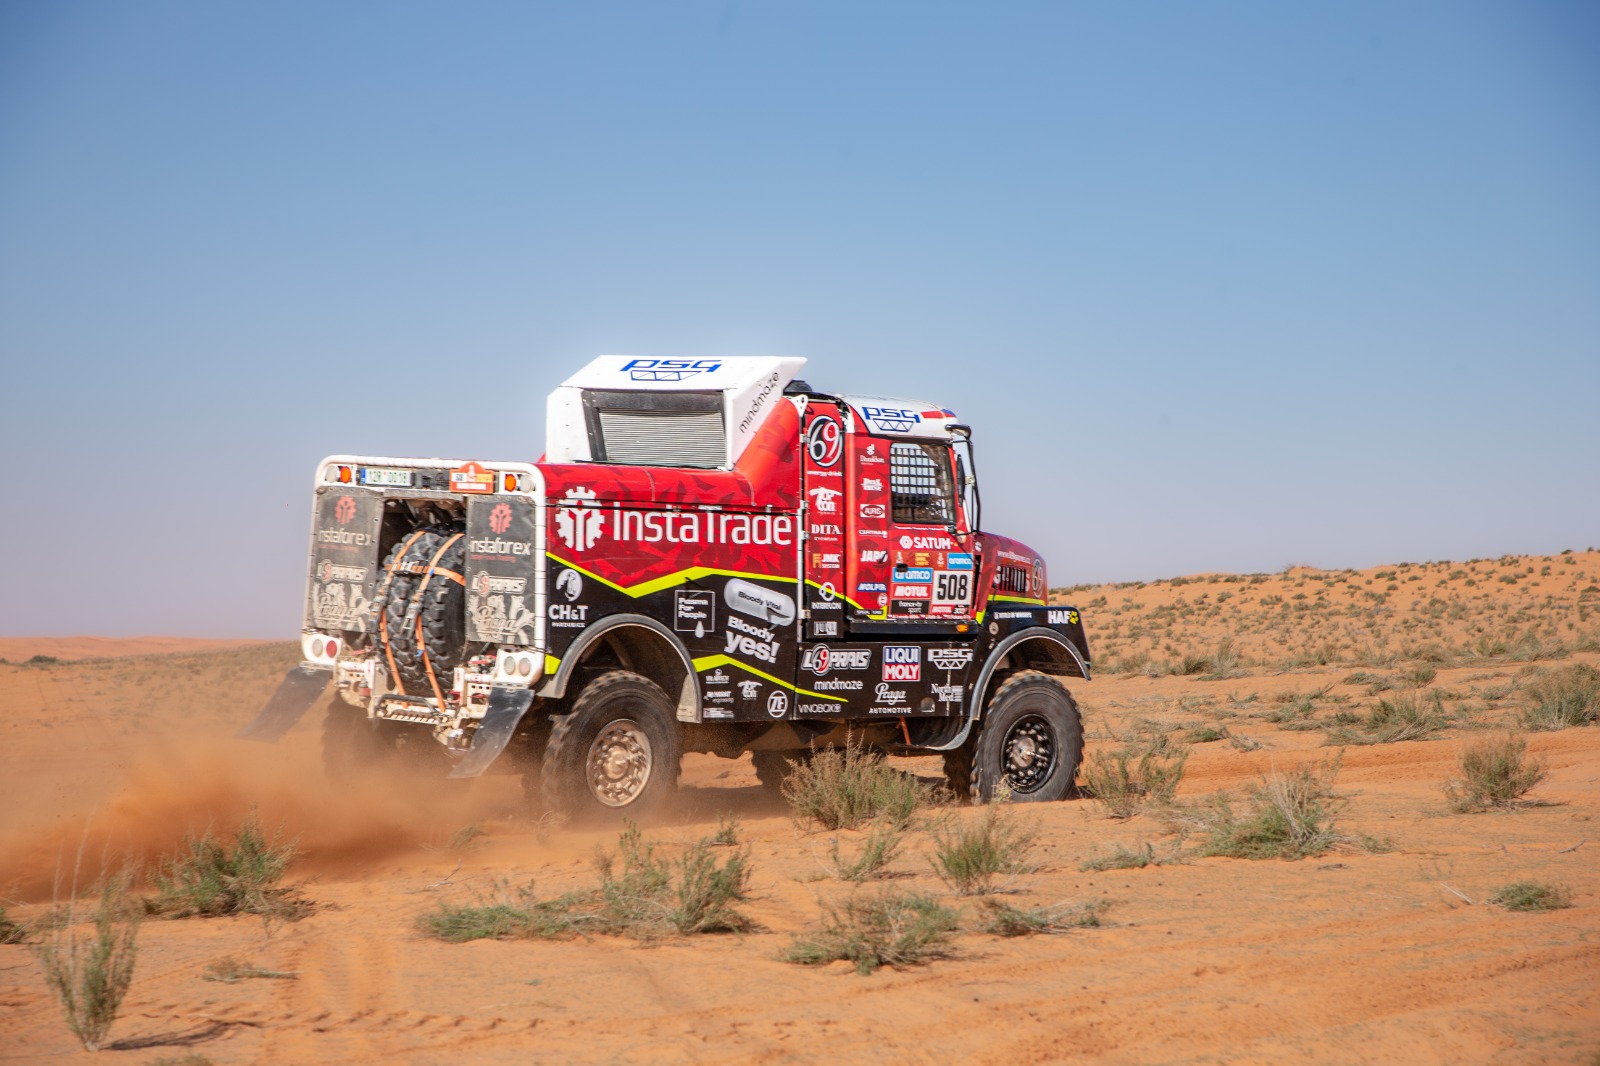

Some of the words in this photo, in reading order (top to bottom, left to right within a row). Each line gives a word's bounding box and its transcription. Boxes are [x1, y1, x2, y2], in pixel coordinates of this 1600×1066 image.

[740, 372, 779, 434] mindmaze
[811, 524, 841, 535] DITA
[913, 537, 951, 549] SATUM
[895, 570, 931, 580] aramco
[894, 586, 928, 597] MOTUL
[937, 574, 969, 600] 508
[738, 591, 764, 605] Bloody
[548, 604, 588, 621] CH&T
[727, 615, 775, 643] Bloody
[724, 630, 780, 664] yes!
[886, 648, 919, 663] LIQUI
[885, 664, 920, 680] MOLY
[814, 677, 864, 691] mindmaze
[875, 682, 907, 705] Praga
[771, 696, 787, 713] ZF
[869, 707, 912, 715] AUTOMOTIVE
